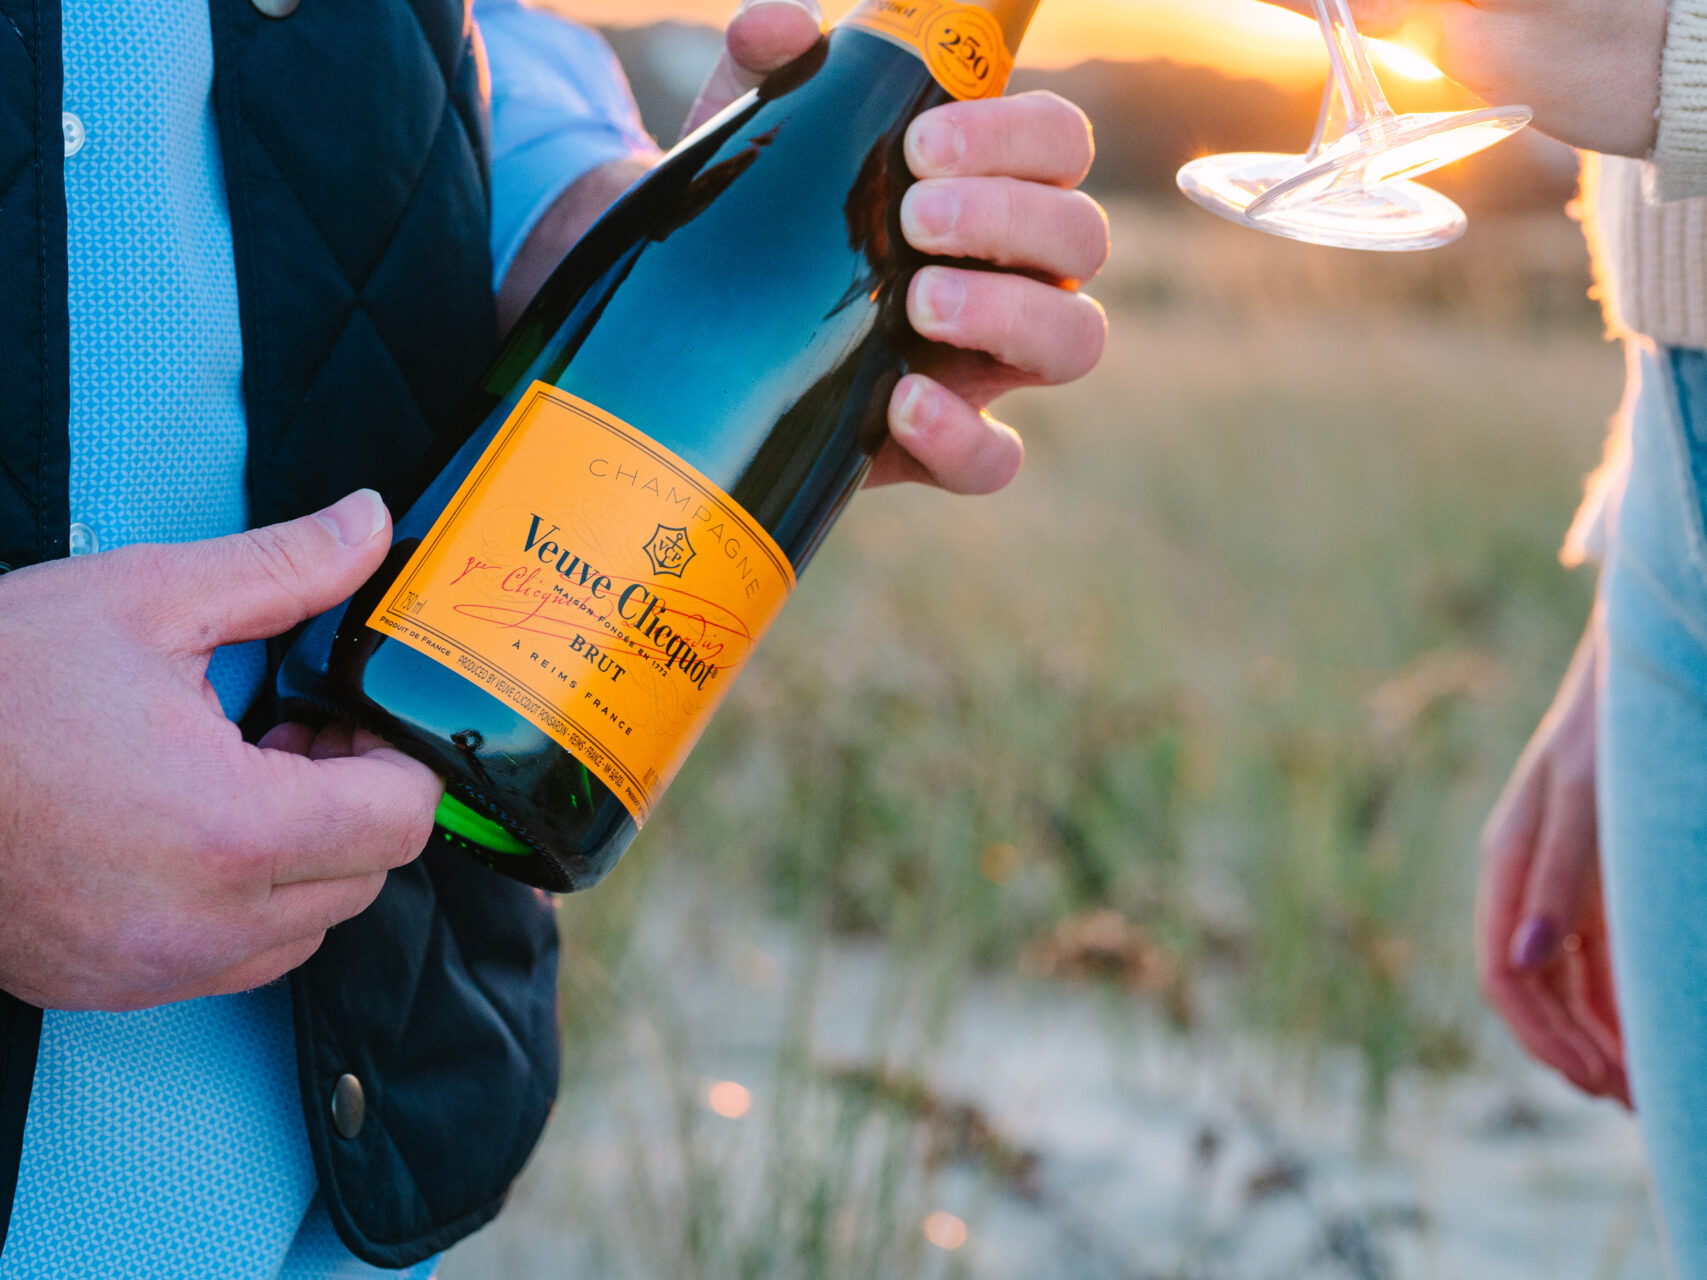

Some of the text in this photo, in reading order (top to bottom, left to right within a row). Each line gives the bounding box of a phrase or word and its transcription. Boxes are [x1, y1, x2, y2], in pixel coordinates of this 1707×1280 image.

[938, 27, 989, 81] 250
[524, 512, 612, 599] Veuve
[589, 458, 760, 600] CHAMPAGNE
[658, 539, 682, 562] VCP
[402, 591, 428, 615] 750 ml
[568, 633, 626, 683] BRUT
[651, 660, 668, 677] 1772
[456, 654, 489, 680] PRODUCED
[486, 673, 497, 686] BY
[495, 679, 516, 698] VEUVE
[512, 691, 541, 715] CLICQUOT
[539, 708, 569, 736] PONSARDIN
[568, 732, 587, 752] REIMS
[585, 746, 605, 767] FRANCE
[511, 639, 633, 736] À REIMS FRANCE
